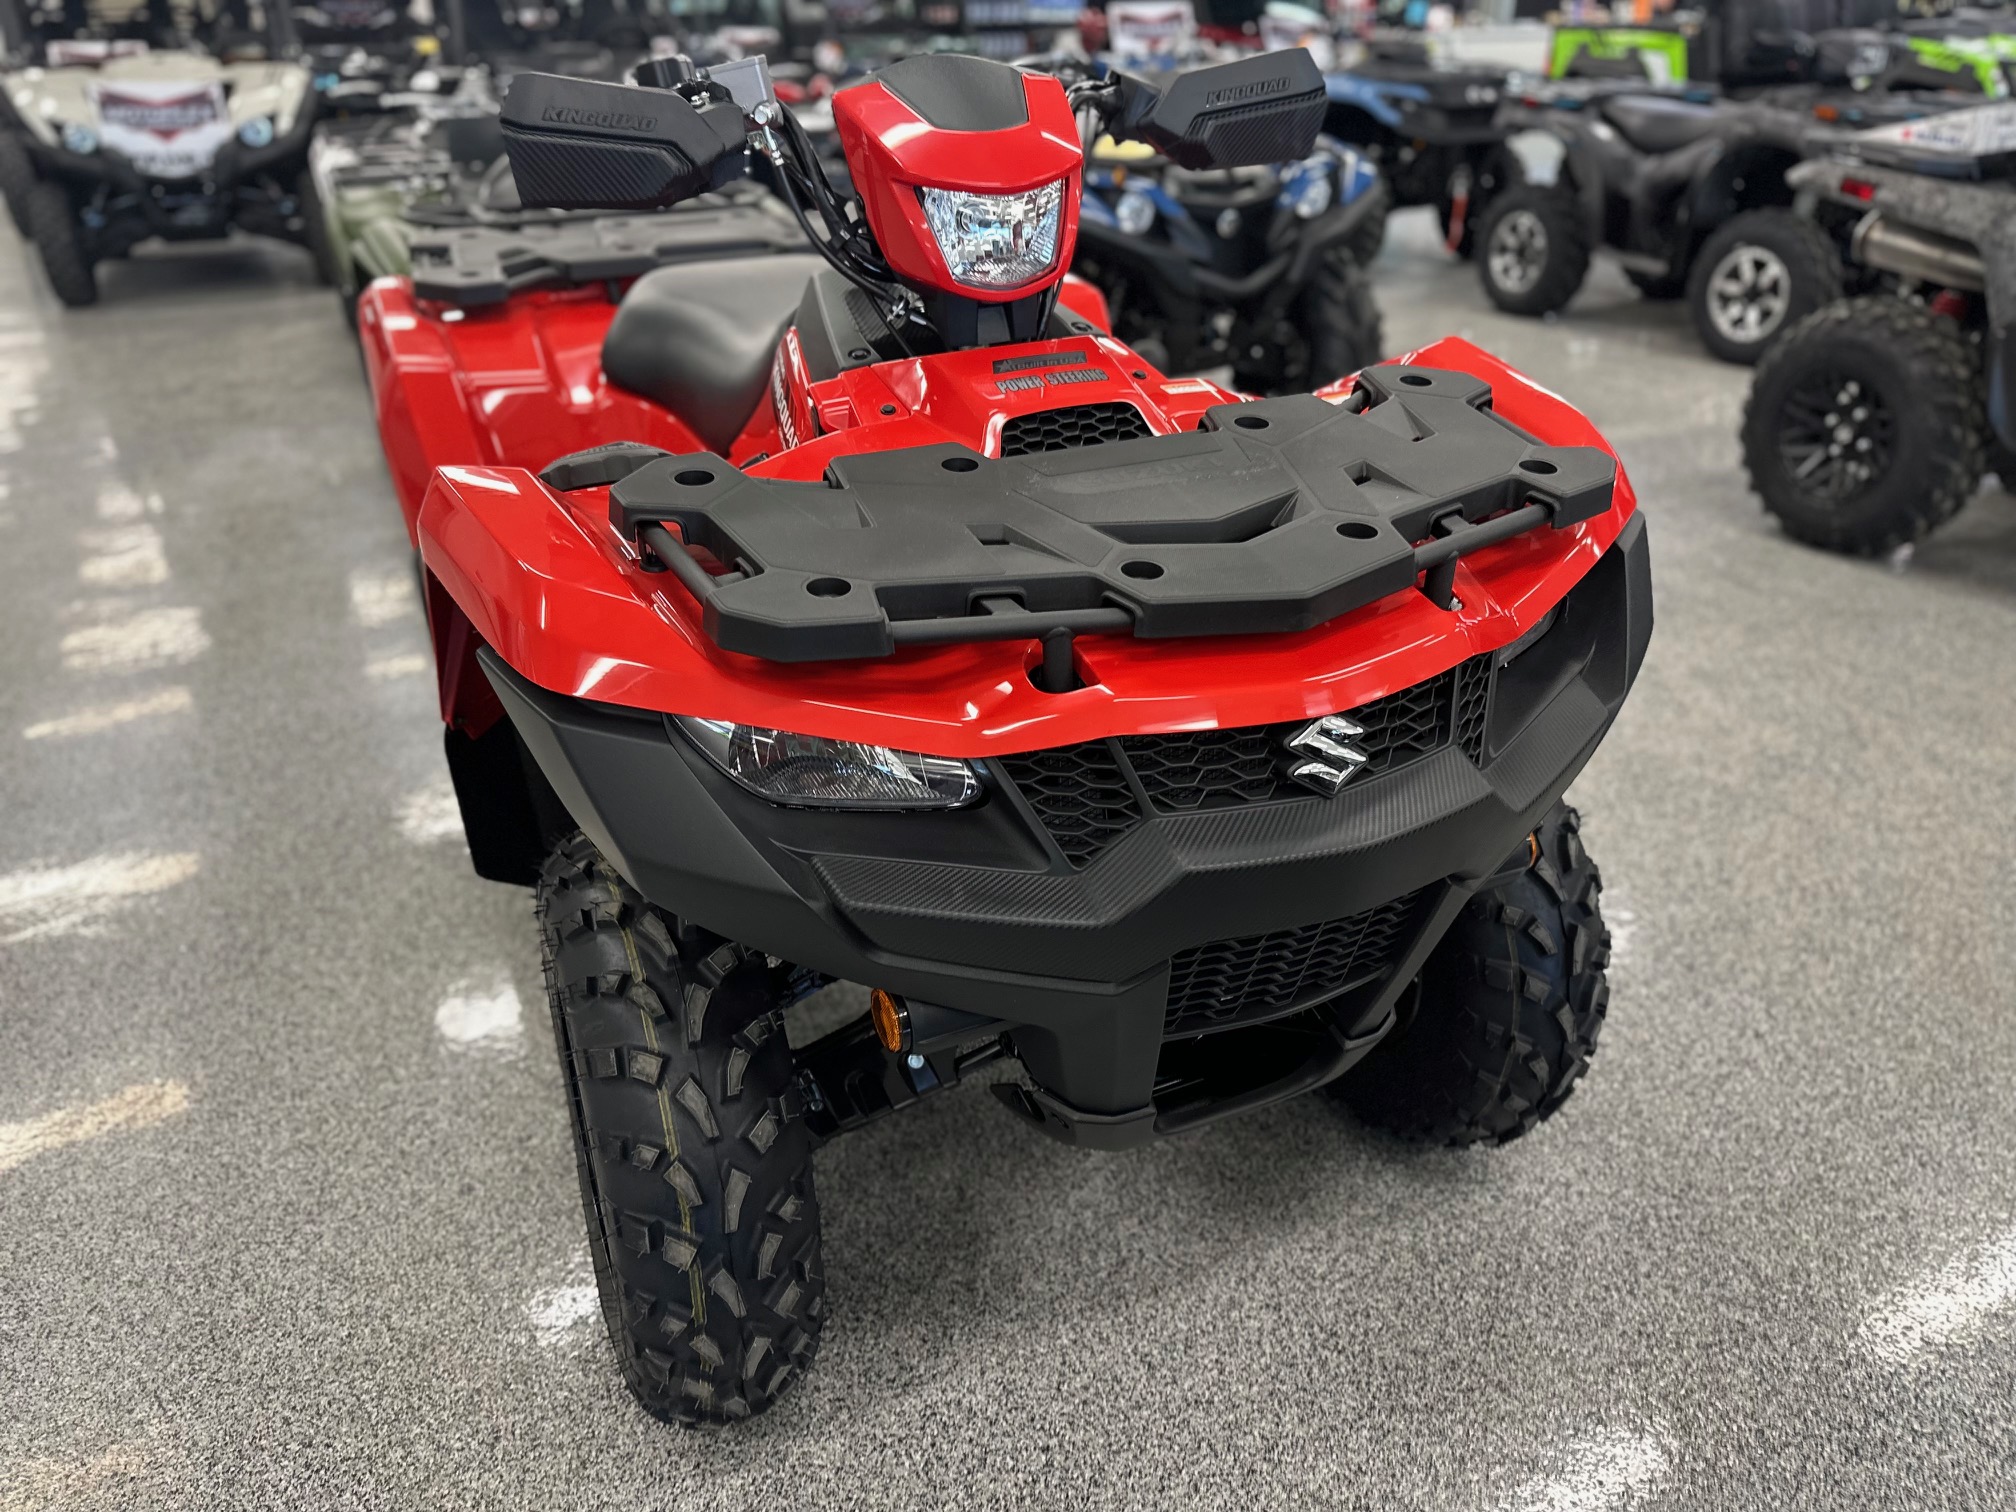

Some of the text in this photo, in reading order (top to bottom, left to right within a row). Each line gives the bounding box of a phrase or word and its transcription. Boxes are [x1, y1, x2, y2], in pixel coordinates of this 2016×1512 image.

[542, 106, 657, 132] KINGQUAD
[995, 368, 1109, 394] POWER STEERING
